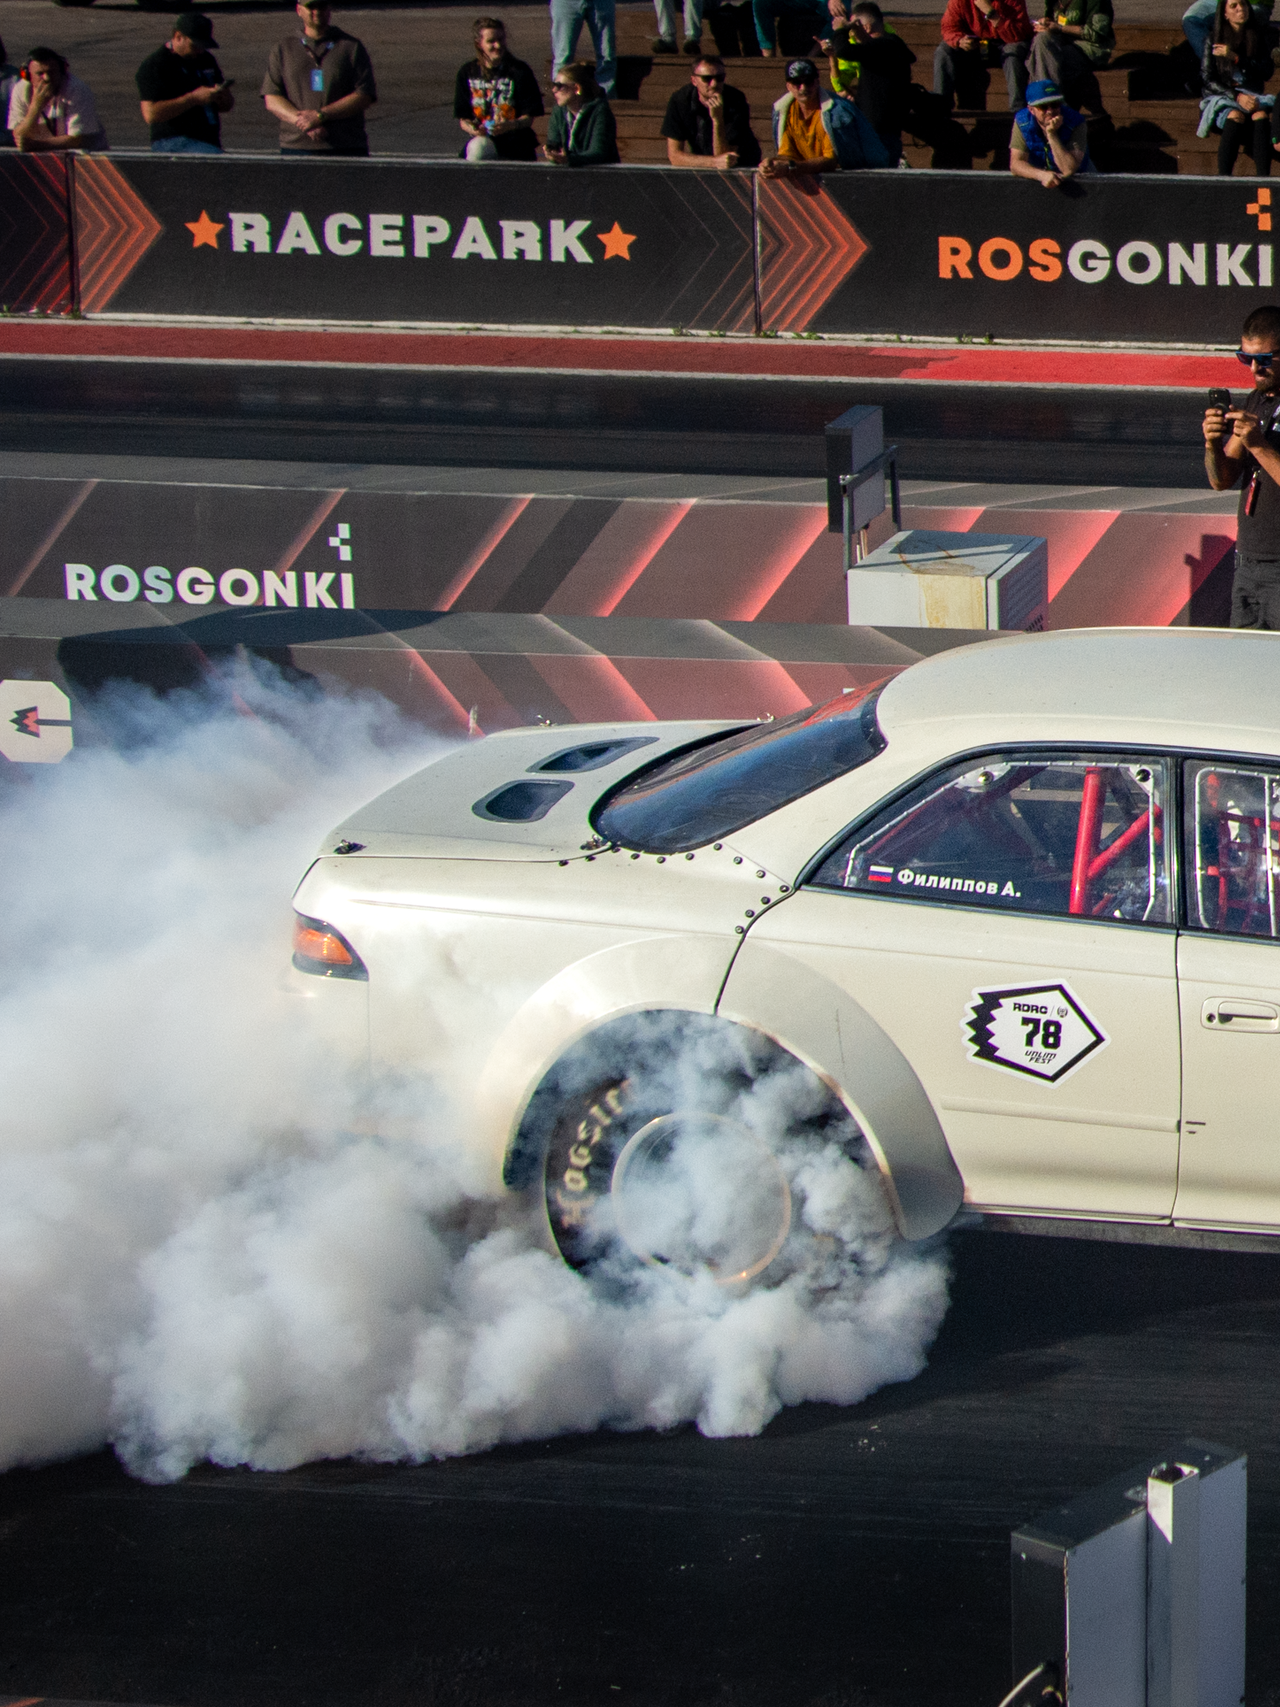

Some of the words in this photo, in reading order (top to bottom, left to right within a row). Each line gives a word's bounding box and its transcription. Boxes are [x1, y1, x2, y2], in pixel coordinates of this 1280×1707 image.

[228, 211, 594, 264] RACEPARK
[938, 235, 1273, 288] ROSGONKI
[65, 562, 355, 609] ROSGONKI
[897, 868, 998, 895] Филиппов
[1000, 880, 1022, 897] А.
[1013, 1002, 1048, 1014] RDRC
[1021, 1016, 1062, 1050] 78
[1028, 1056, 1053, 1065] FEST
